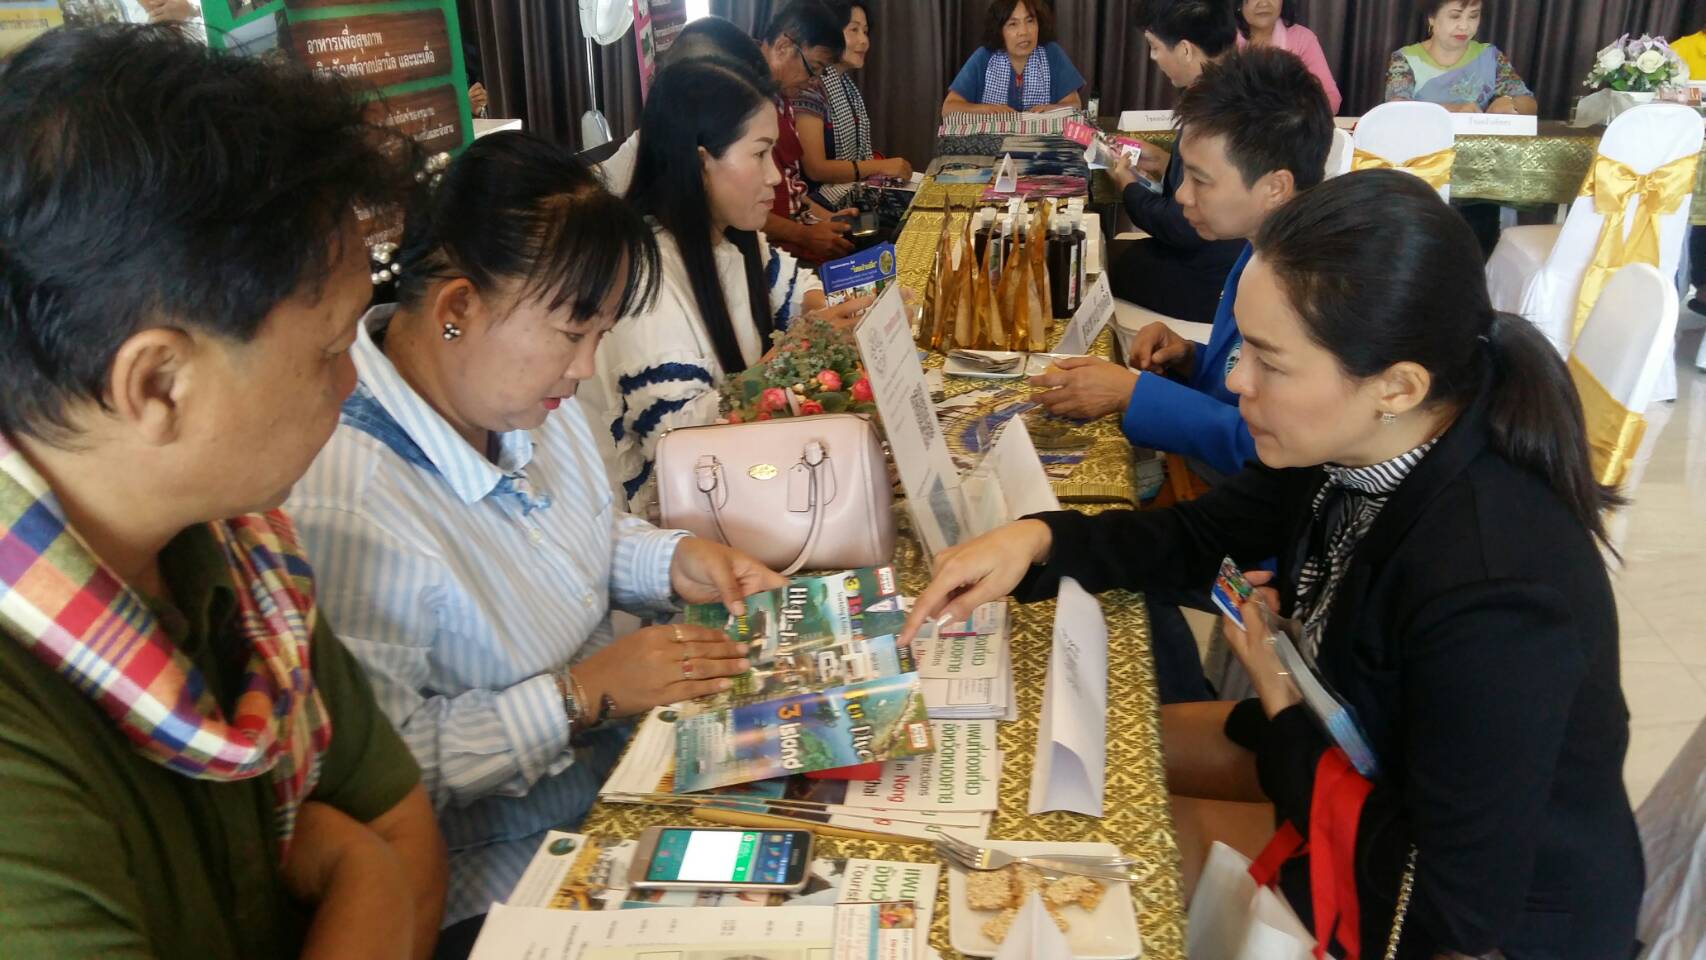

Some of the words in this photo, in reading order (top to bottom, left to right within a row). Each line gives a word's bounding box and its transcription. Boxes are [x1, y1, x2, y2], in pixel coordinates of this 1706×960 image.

[307, 24, 383, 54] อาหารเพื่อสุขภาพ
[777, 703, 803, 721] 3
[778, 723, 804, 770] Island
[966, 724, 991, 796] แผนที่ท่องเที่ยว
[895, 763, 907, 771] in
[937, 723, 961, 804] จังหวัดหนองคาย
[863, 780, 880, 797] hai
[887, 775, 910, 803] Nong
